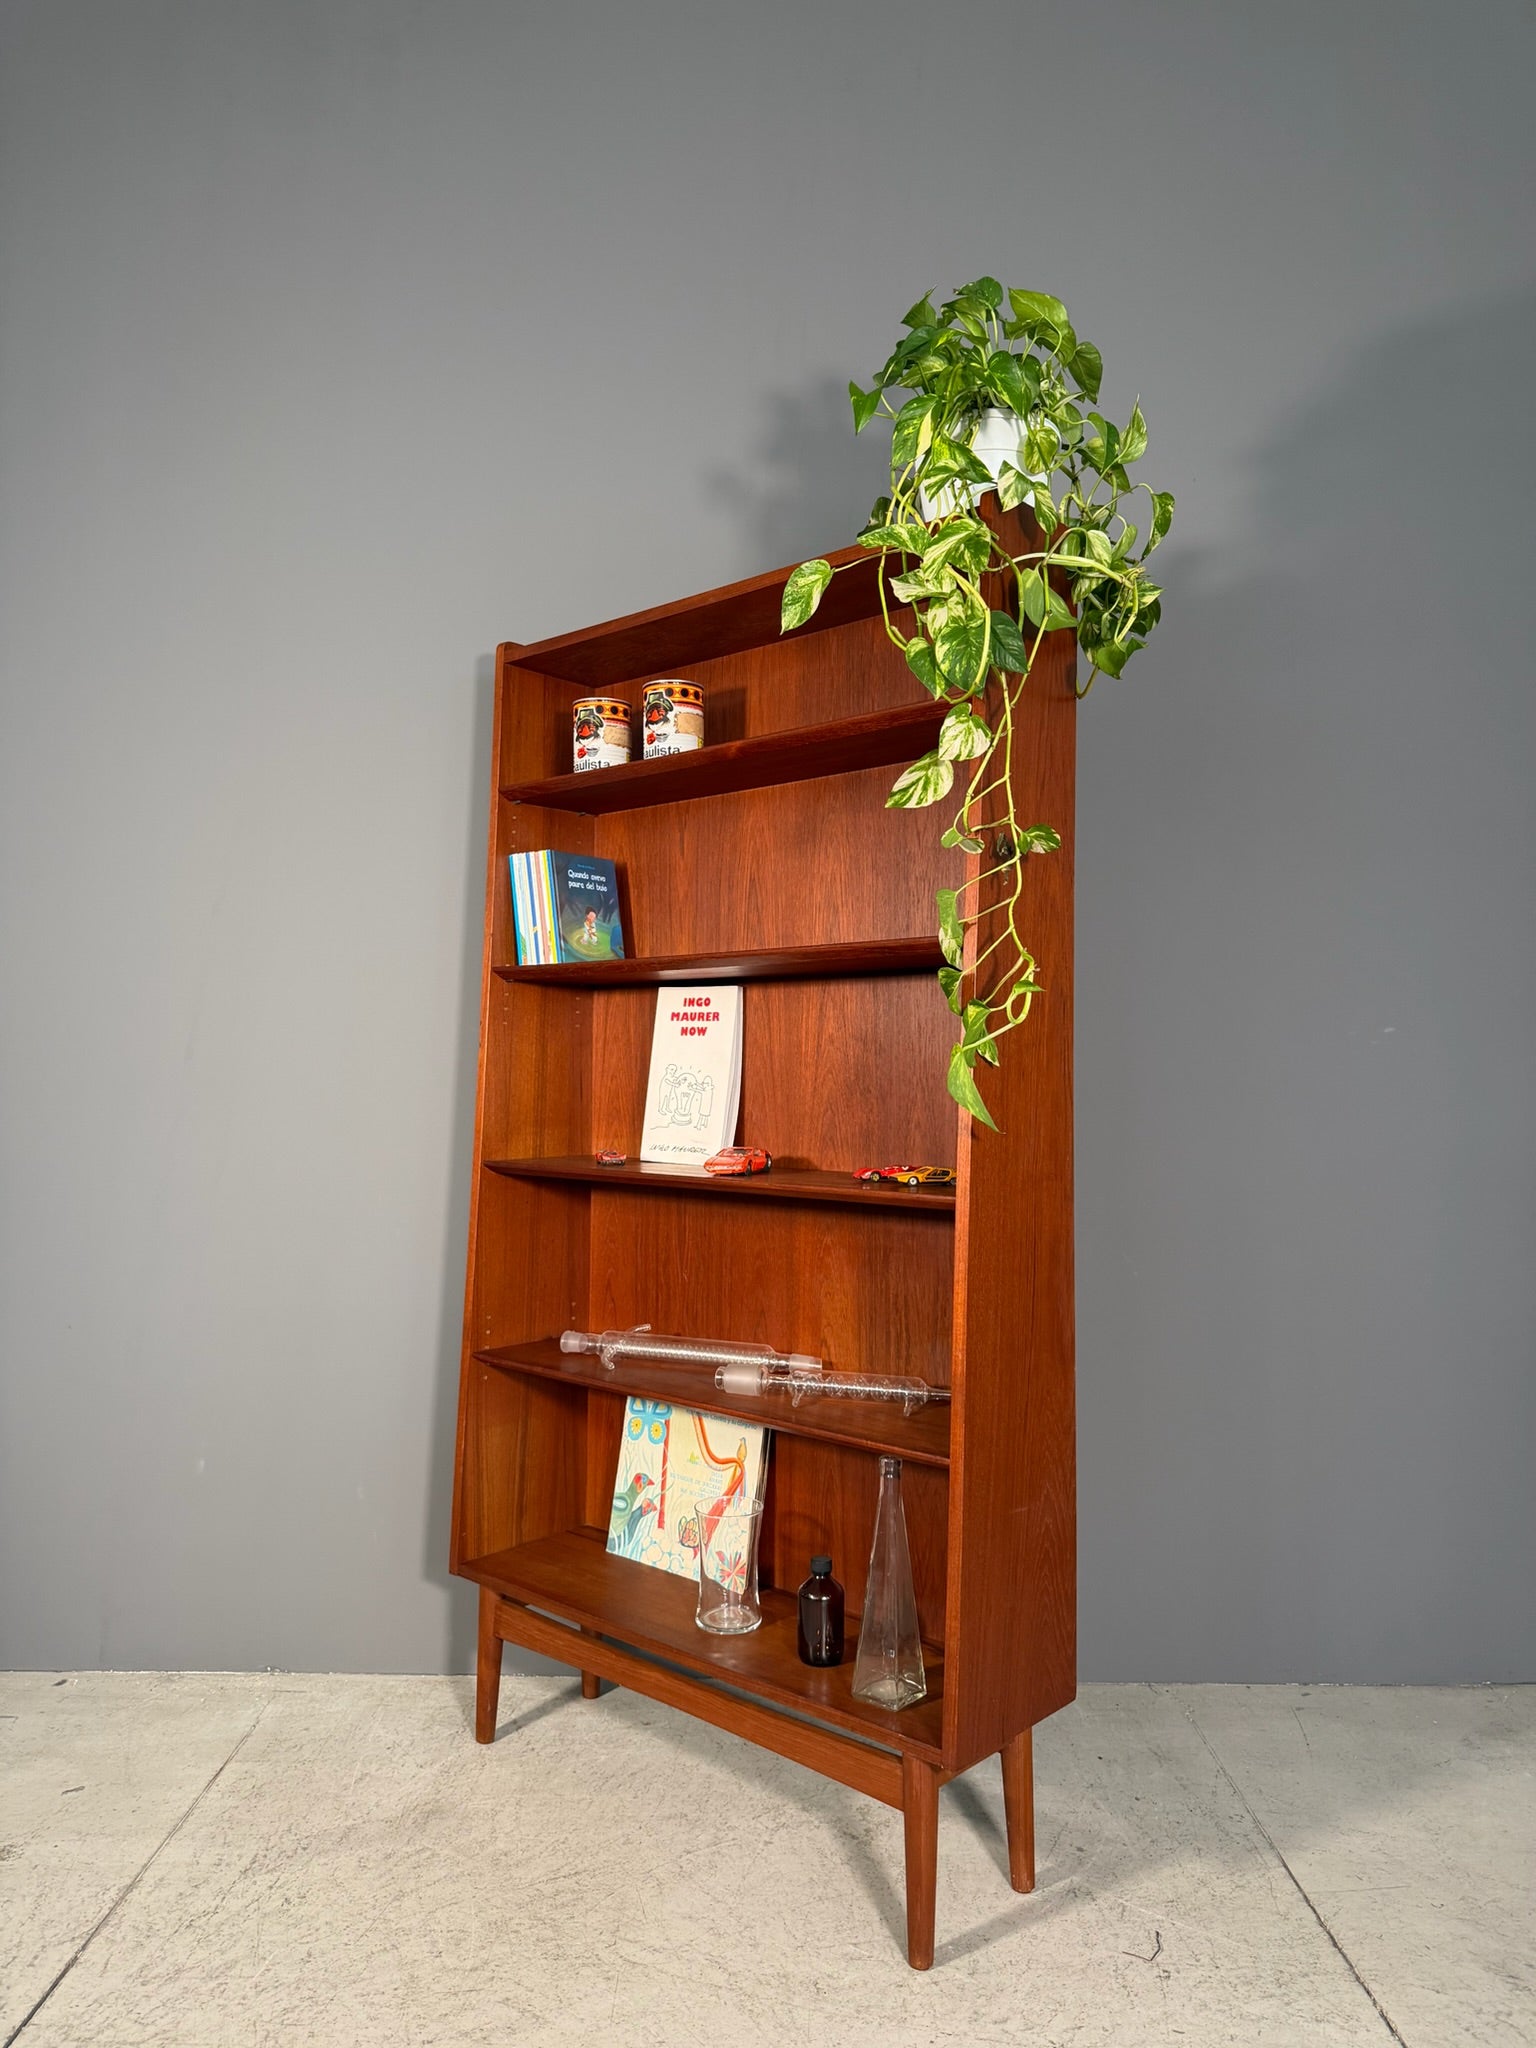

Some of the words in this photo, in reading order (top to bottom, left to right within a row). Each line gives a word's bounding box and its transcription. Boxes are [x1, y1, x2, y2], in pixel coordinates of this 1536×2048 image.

[567, 869, 589, 879] Quando
[585, 882, 595, 890] del
[595, 883, 608, 892] buio
[683, 997, 711, 1007] INGO
[670, 1011, 720, 1022] MAURER
[680, 1026, 708, 1037] NOW
